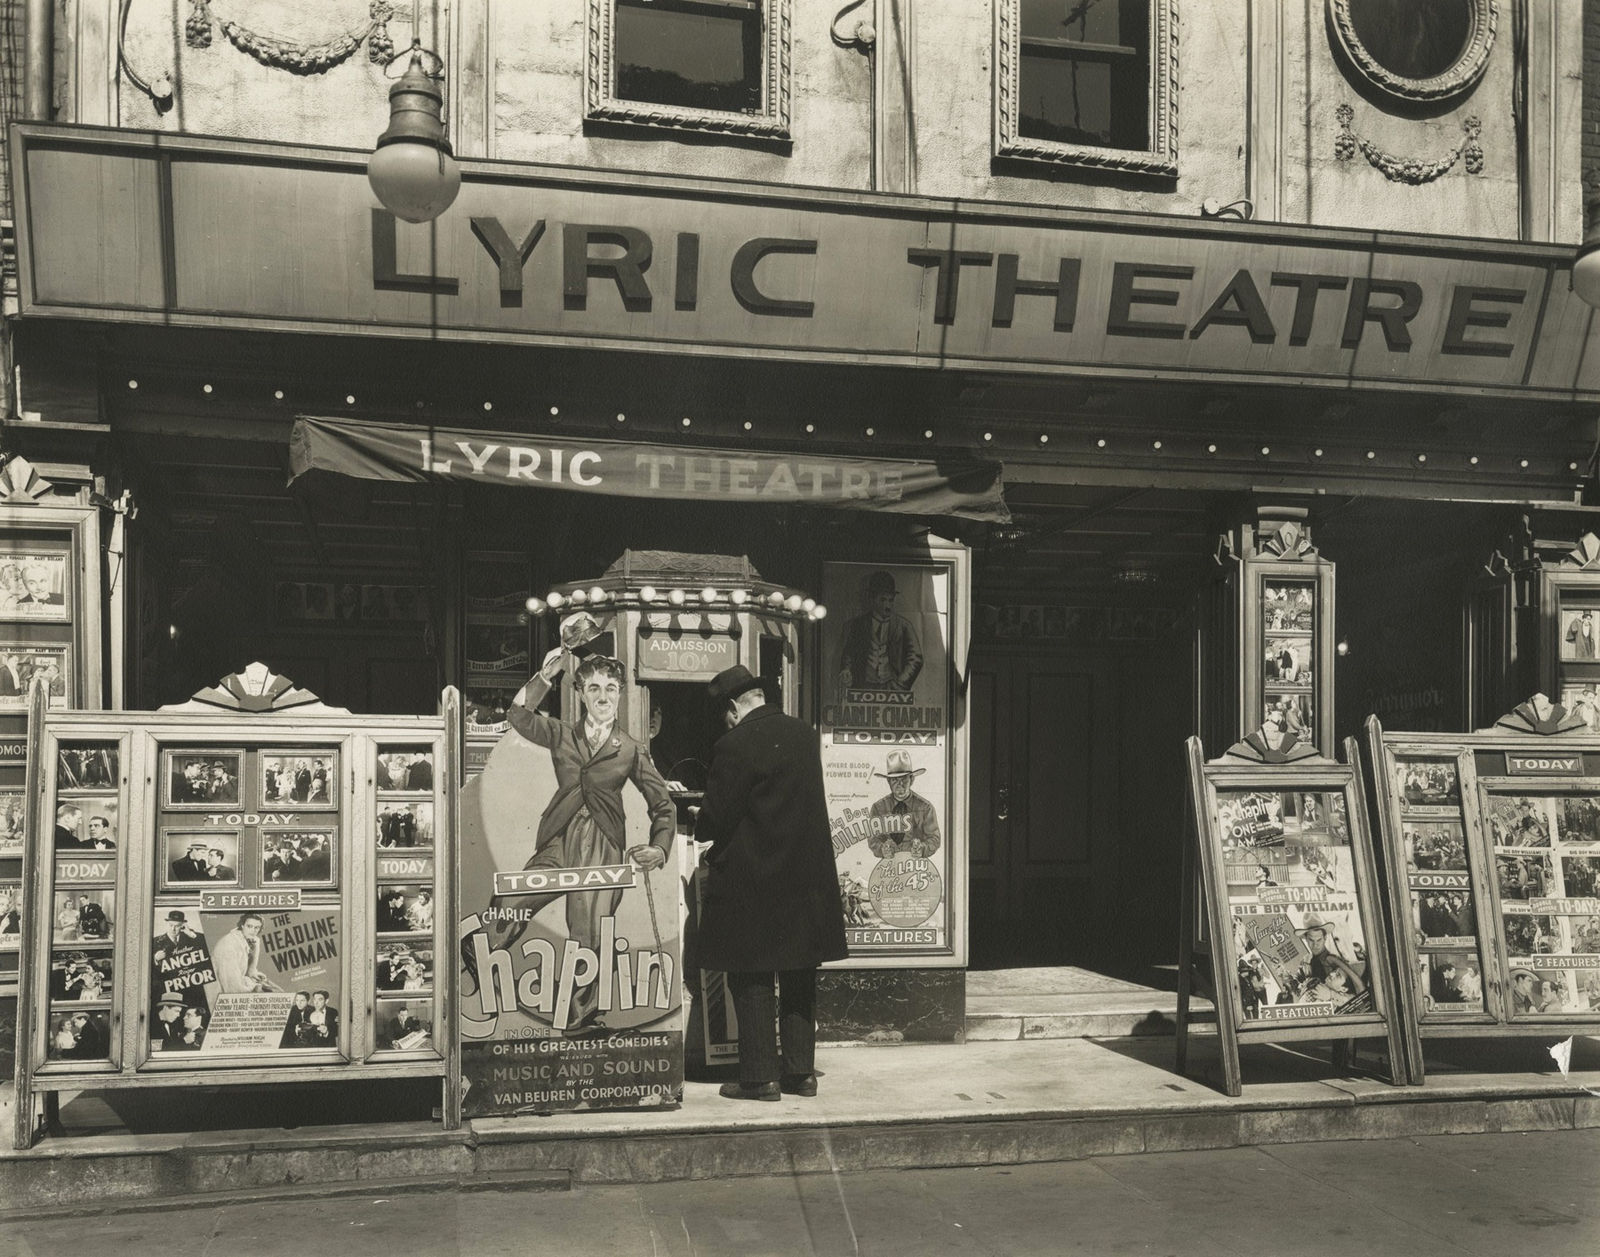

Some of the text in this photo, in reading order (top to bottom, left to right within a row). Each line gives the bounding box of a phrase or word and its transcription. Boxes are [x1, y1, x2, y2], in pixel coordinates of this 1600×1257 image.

[372, 207, 1527, 358] LYRIC THEATRE
[420, 439, 904, 500] LYRIC THEATRE
[650, 640, 727, 653] ADMISSION
[667, 652, 709, 671] 10¢
[850, 692, 910, 702] TODAY
[822, 704, 943, 729] CHARLIE CHAPLIN
[838, 731, 933, 744] TO-DAY
[1512, 759, 1575, 770] TODAY
[208, 814, 294, 825] TODAY
[1232, 822, 1257, 838] ONE
[58, 864, 110, 878] TODAY
[381, 860, 427, 874] TODAY
[898, 859, 928, 876] LAW
[503, 868, 626, 890] TO-DAY
[1408, 876, 1469, 886] TODAY
[871, 882, 884, 900] of
[887, 879, 904, 893] the
[1285, 887, 1324, 902] TO-DAY
[207, 895, 295, 906] 2 FEATURES
[1557, 900, 1595, 913] TO-DAY
[482, 907, 533, 924] CHARLIE
[1234, 902, 1354, 915] BIG BOY WILLIAMS
[270, 913, 291, 928] THE
[262, 916, 338, 953] HEADLINE
[854, 931, 933, 943] FEATURES
[160, 949, 209, 973] ANGEL
[271, 938, 338, 973] WOMAN
[1537, 958, 1597, 967] 2 FEATURES
[164, 969, 216, 993] PRYOR
[460, 915, 675, 1038] Chaplin
[1264, 1006, 1330, 1019] 2 FEATURES
[505, 1026, 550, 1039] IN ONE
[493, 1045, 512, 1055] OF
[514, 1043, 535, 1053] HIS
[607, 1036, 669, 1049] COMEDIES
[494, 1059, 671, 1081] MUSIC AND SOUND
[494, 1083, 672, 1105] VAN BEUREN CORPORATION
